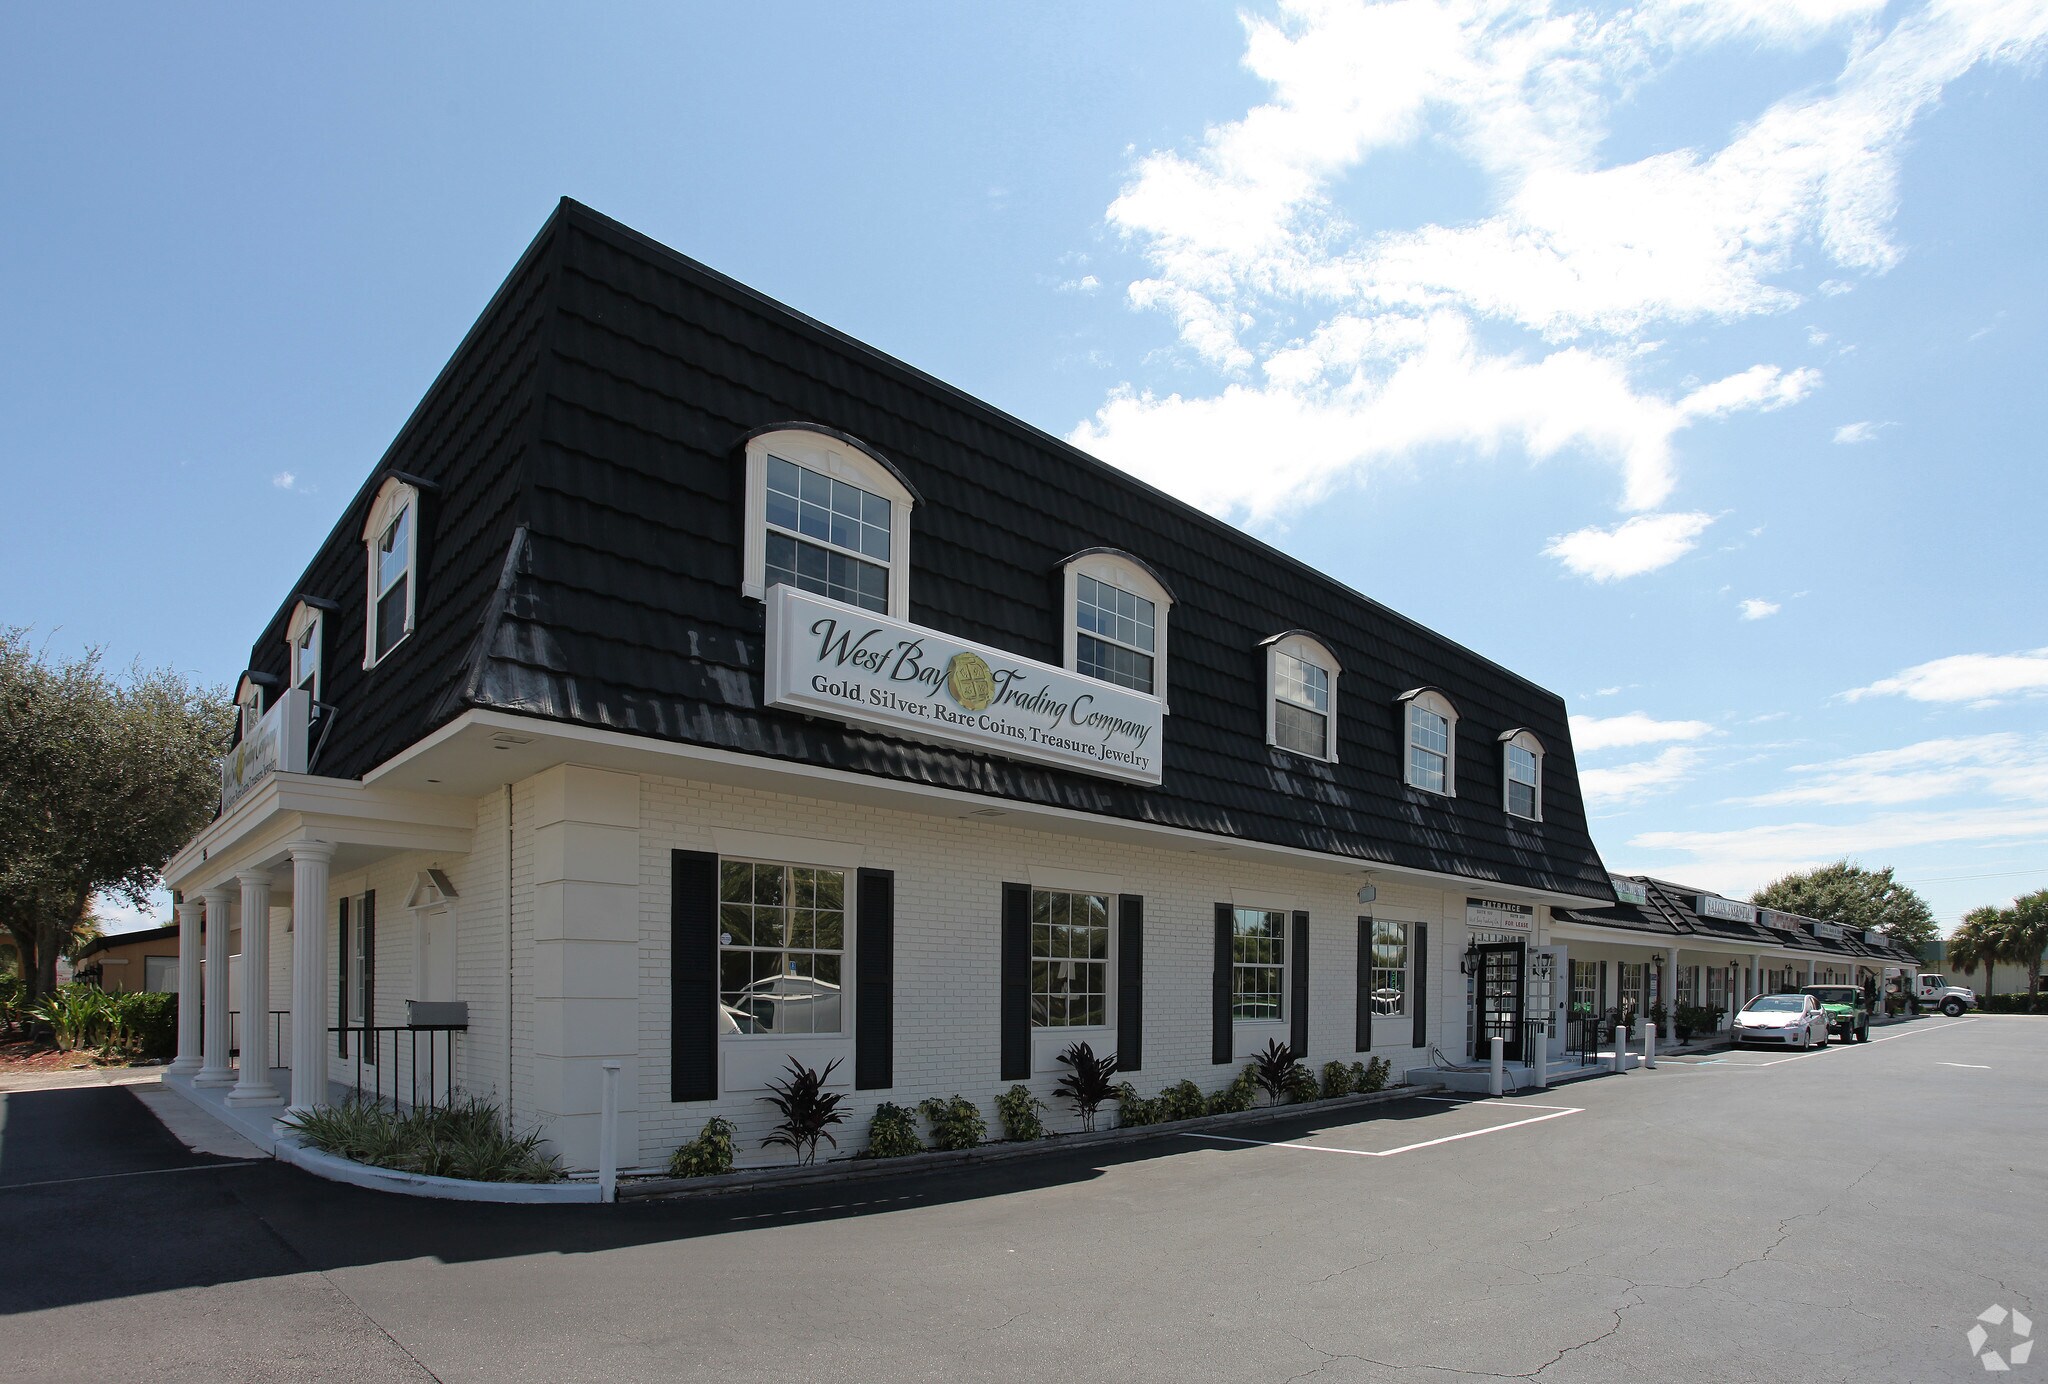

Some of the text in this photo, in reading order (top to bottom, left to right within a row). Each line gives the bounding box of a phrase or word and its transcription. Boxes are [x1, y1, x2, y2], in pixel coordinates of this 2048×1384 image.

[811, 618, 1152, 750] West Bay Trading Company
[812, 674, 1150, 771] Gold, Silver, Rare Coins, Treasure, Jewelry
[1482, 900, 1521, 912] ENTRANCE
